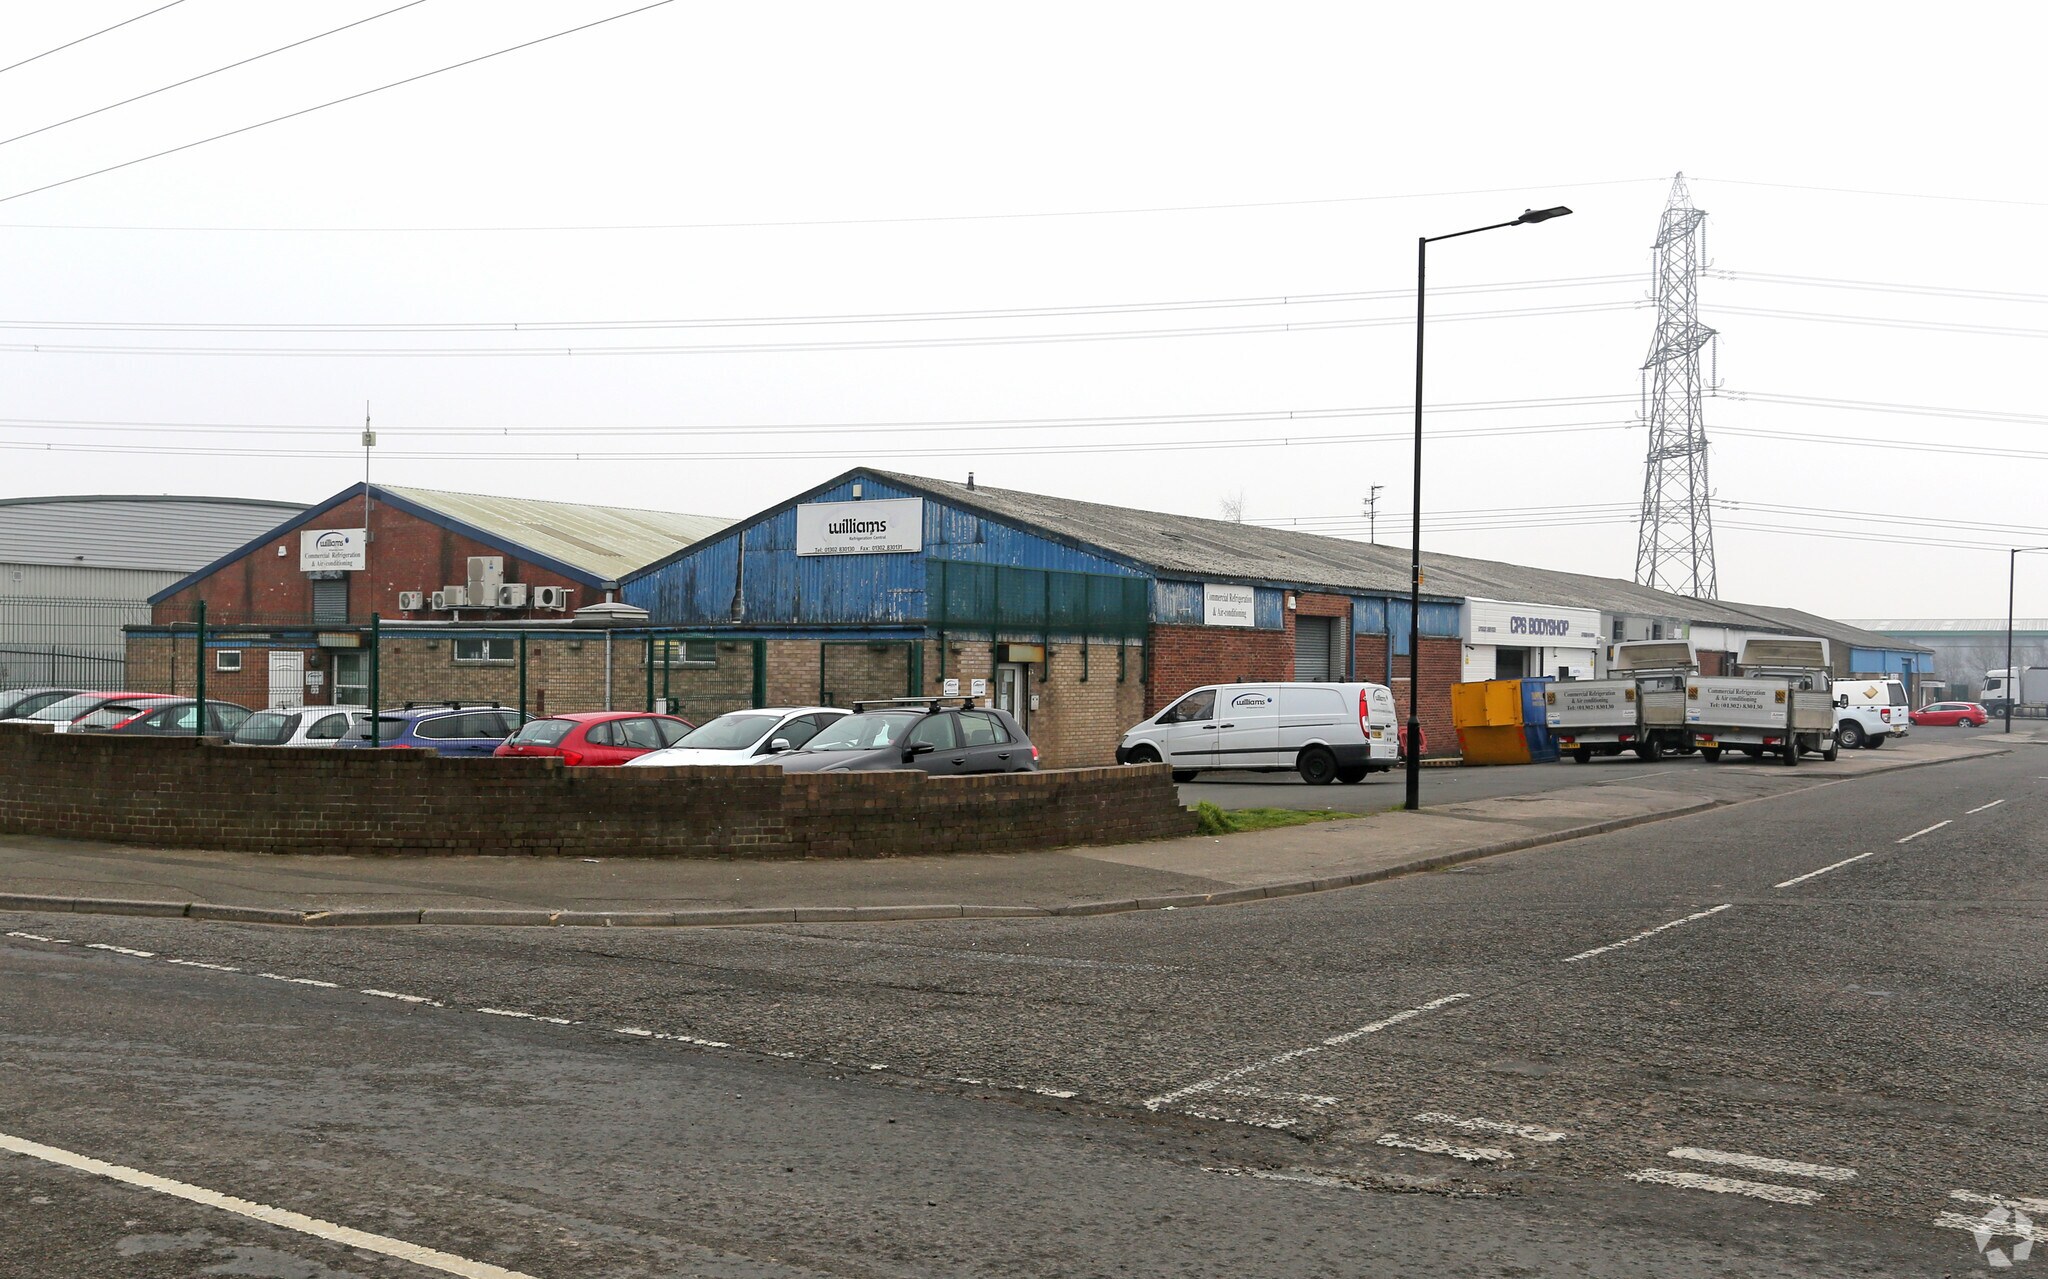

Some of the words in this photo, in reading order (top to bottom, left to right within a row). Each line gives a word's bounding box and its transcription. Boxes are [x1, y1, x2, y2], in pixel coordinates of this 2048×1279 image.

[828, 518, 887, 535] williams
[320, 539, 343, 547] williams
[1510, 616, 1527, 634] CPS
[1529, 617, 1569, 636] BODYSHOP
[1735, 688, 1766, 696] Refrigeration
